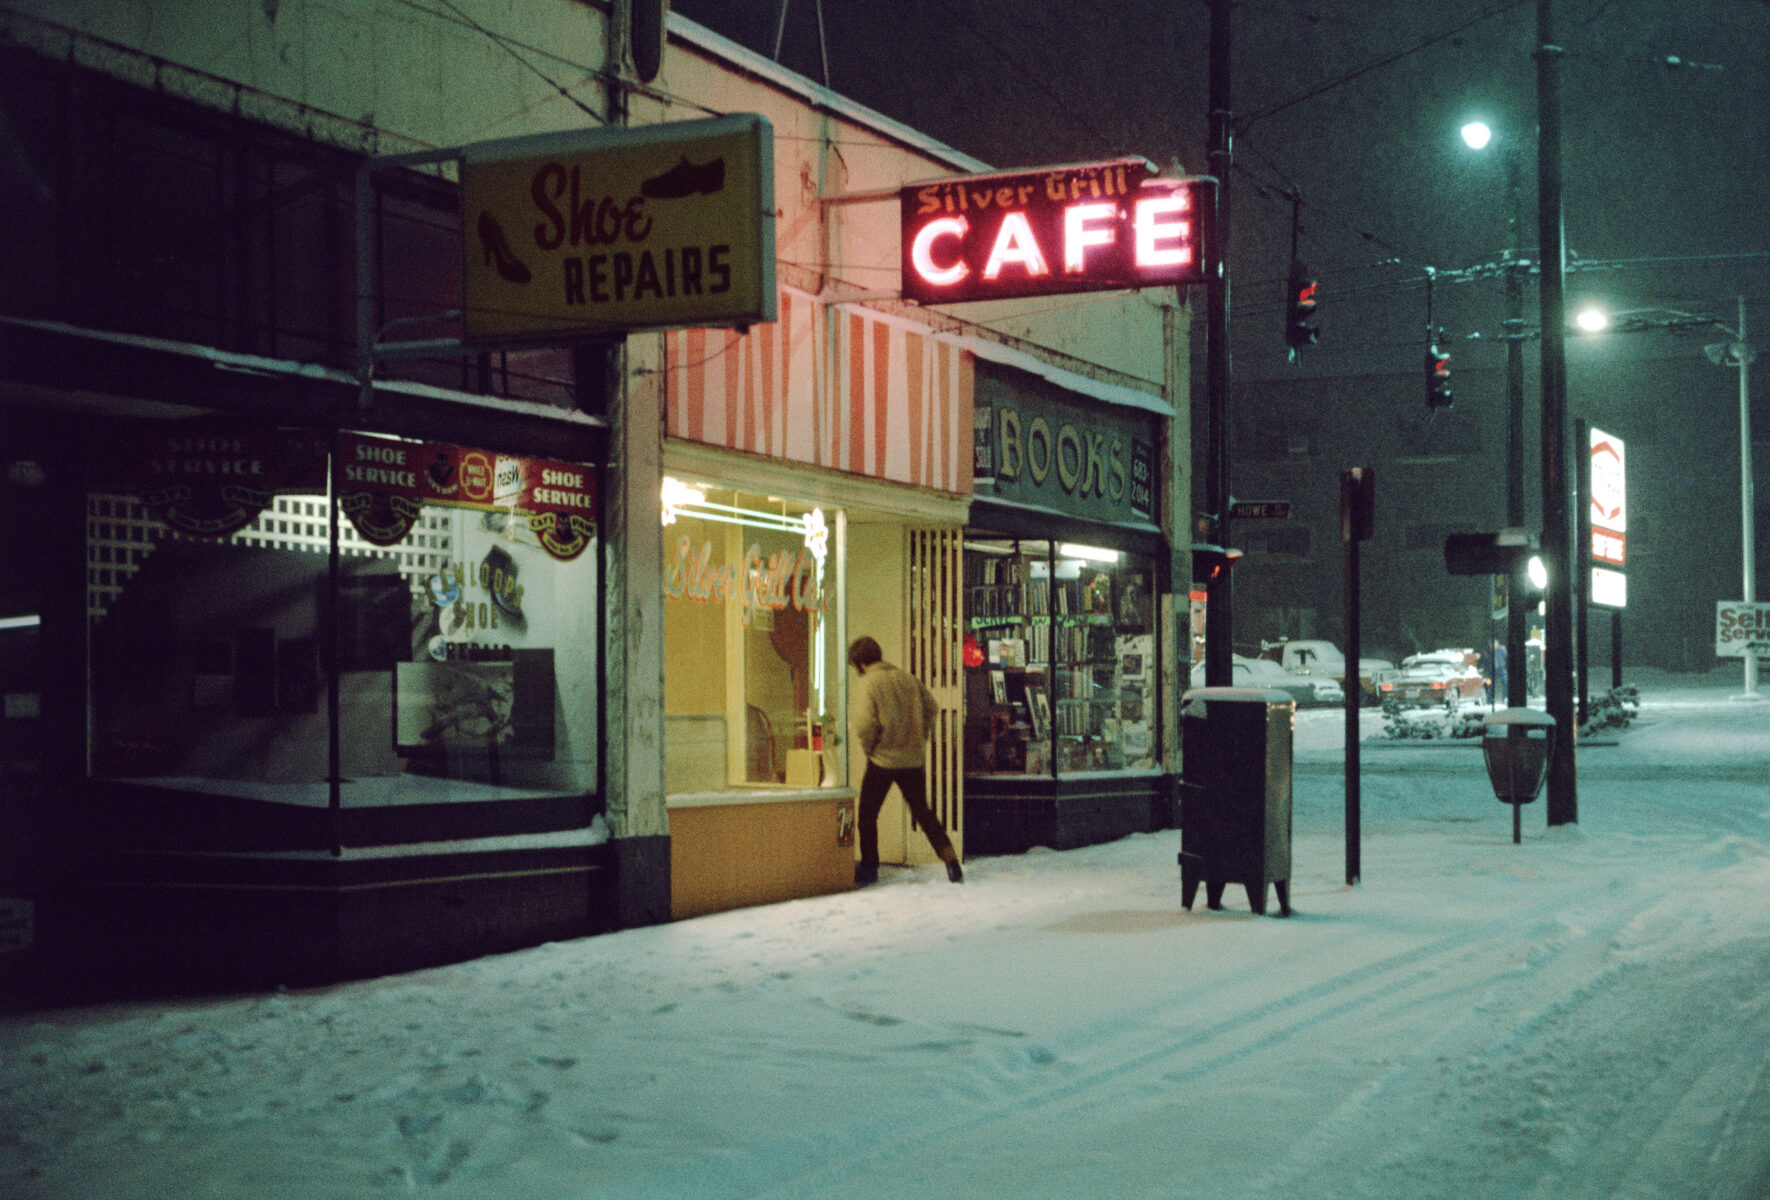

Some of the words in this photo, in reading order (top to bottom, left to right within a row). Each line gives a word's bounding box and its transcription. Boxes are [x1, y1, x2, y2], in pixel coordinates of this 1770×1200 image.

[530, 162, 653, 251] Shoe
[916, 181, 1036, 215] Silver
[1045, 165, 1130, 202] Grill
[910, 192, 1194, 288] CAFE
[563, 243, 731, 307] REPAIRS
[356, 443, 407, 466] SHOE
[999, 407, 1126, 500] BOOKS
[344, 463, 418, 488] SERVICE
[541, 467, 584, 489] SHOE
[533, 486, 592, 509] SERVICE
[1237, 504, 1268, 517] HOWE
[663, 534, 737, 603] Silver
[740, 543, 797, 628] Grill
[452, 601, 499, 630] SHOE
